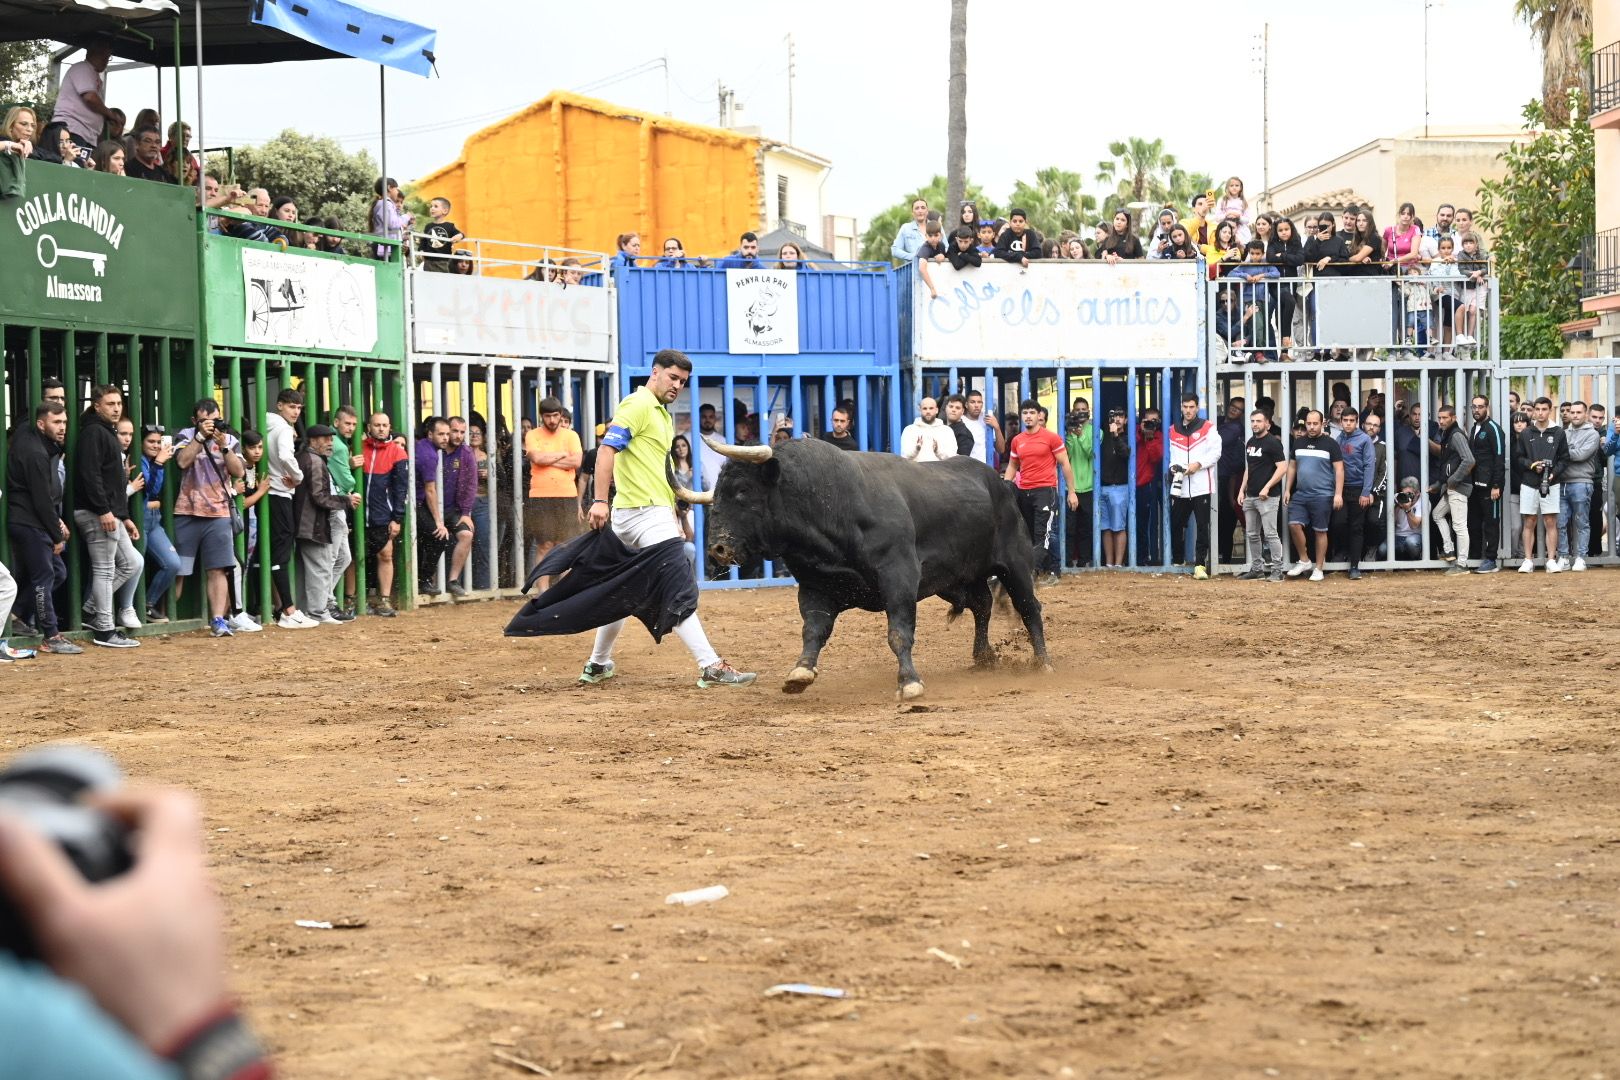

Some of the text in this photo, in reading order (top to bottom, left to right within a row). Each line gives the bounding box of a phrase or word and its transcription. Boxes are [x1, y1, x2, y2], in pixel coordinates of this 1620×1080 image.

[16, 192, 124, 250] COLLA GANDIA
[47, 275, 102, 302] Almassora
[736, 275, 788, 289] PENYA LA PAU
[928, 280, 1182, 334] Colla els amics
[744, 337, 783, 347] ALMASSORA
